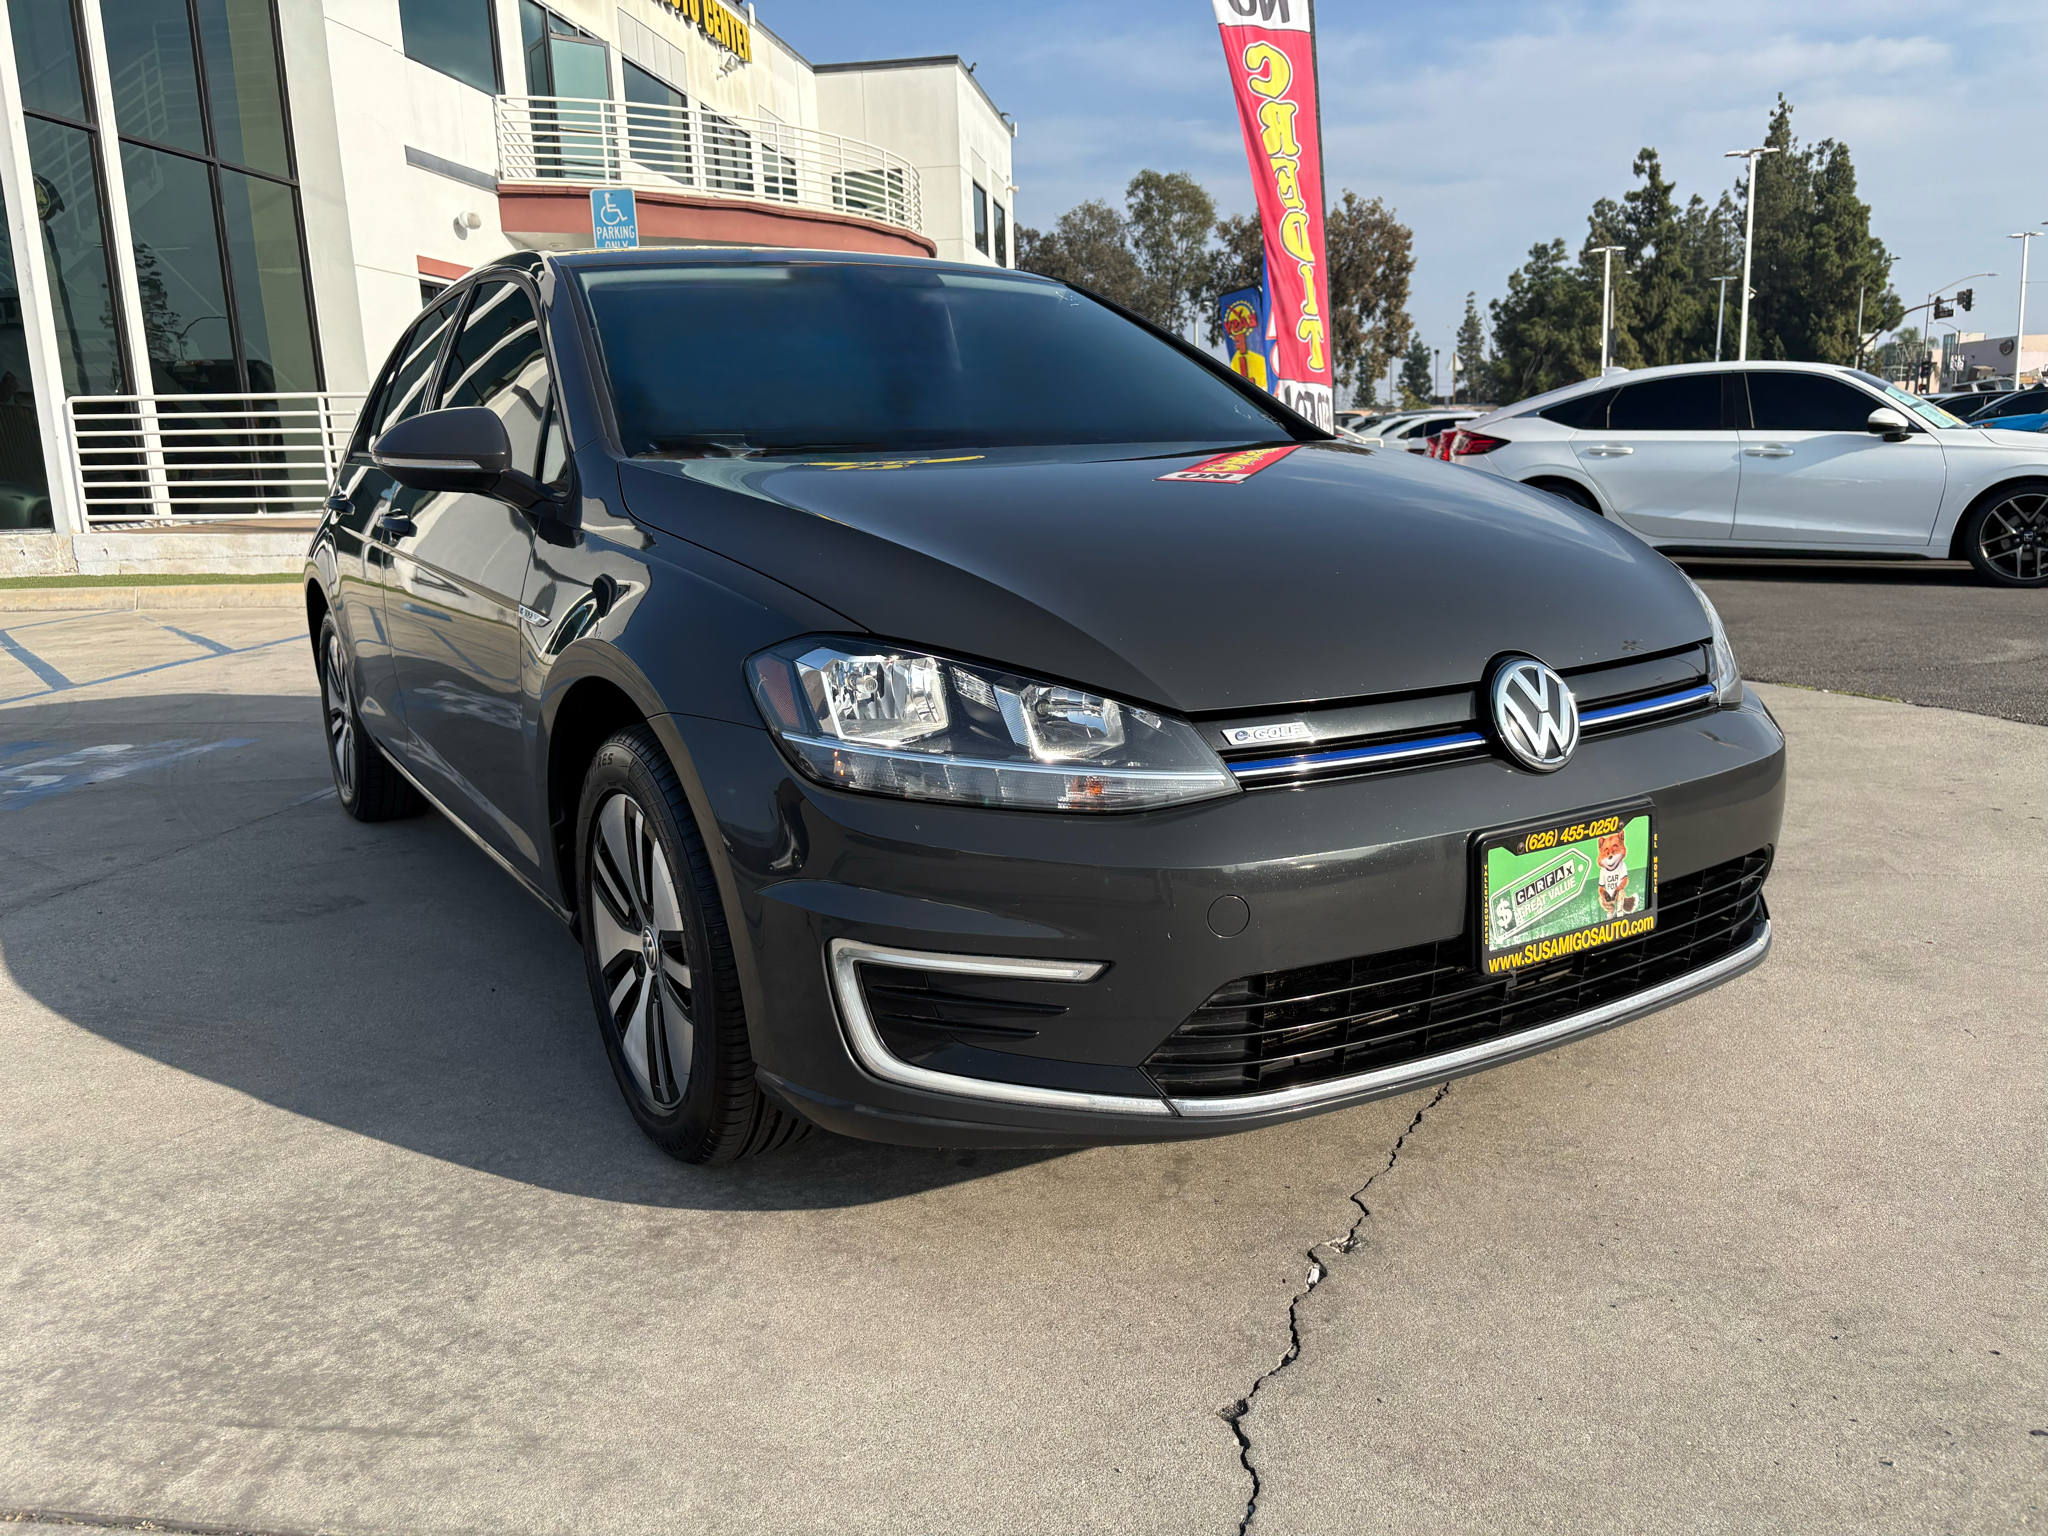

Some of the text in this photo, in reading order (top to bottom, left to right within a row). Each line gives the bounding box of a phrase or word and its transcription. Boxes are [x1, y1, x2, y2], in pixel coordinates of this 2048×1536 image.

[702, 0, 753, 64] CENTER
[596, 225, 635, 240] PARKING
[1525, 816, 1619, 852] (626) 455-0250
[1516, 861, 1574, 905] CARFAX
[1520, 877, 1577, 917] GREAT VALUE
[1606, 874, 1619, 883] CAR
[1606, 882, 1618, 890] FOX
[1488, 916, 1654, 973] www.SUSAMIGOSAUTO.com
